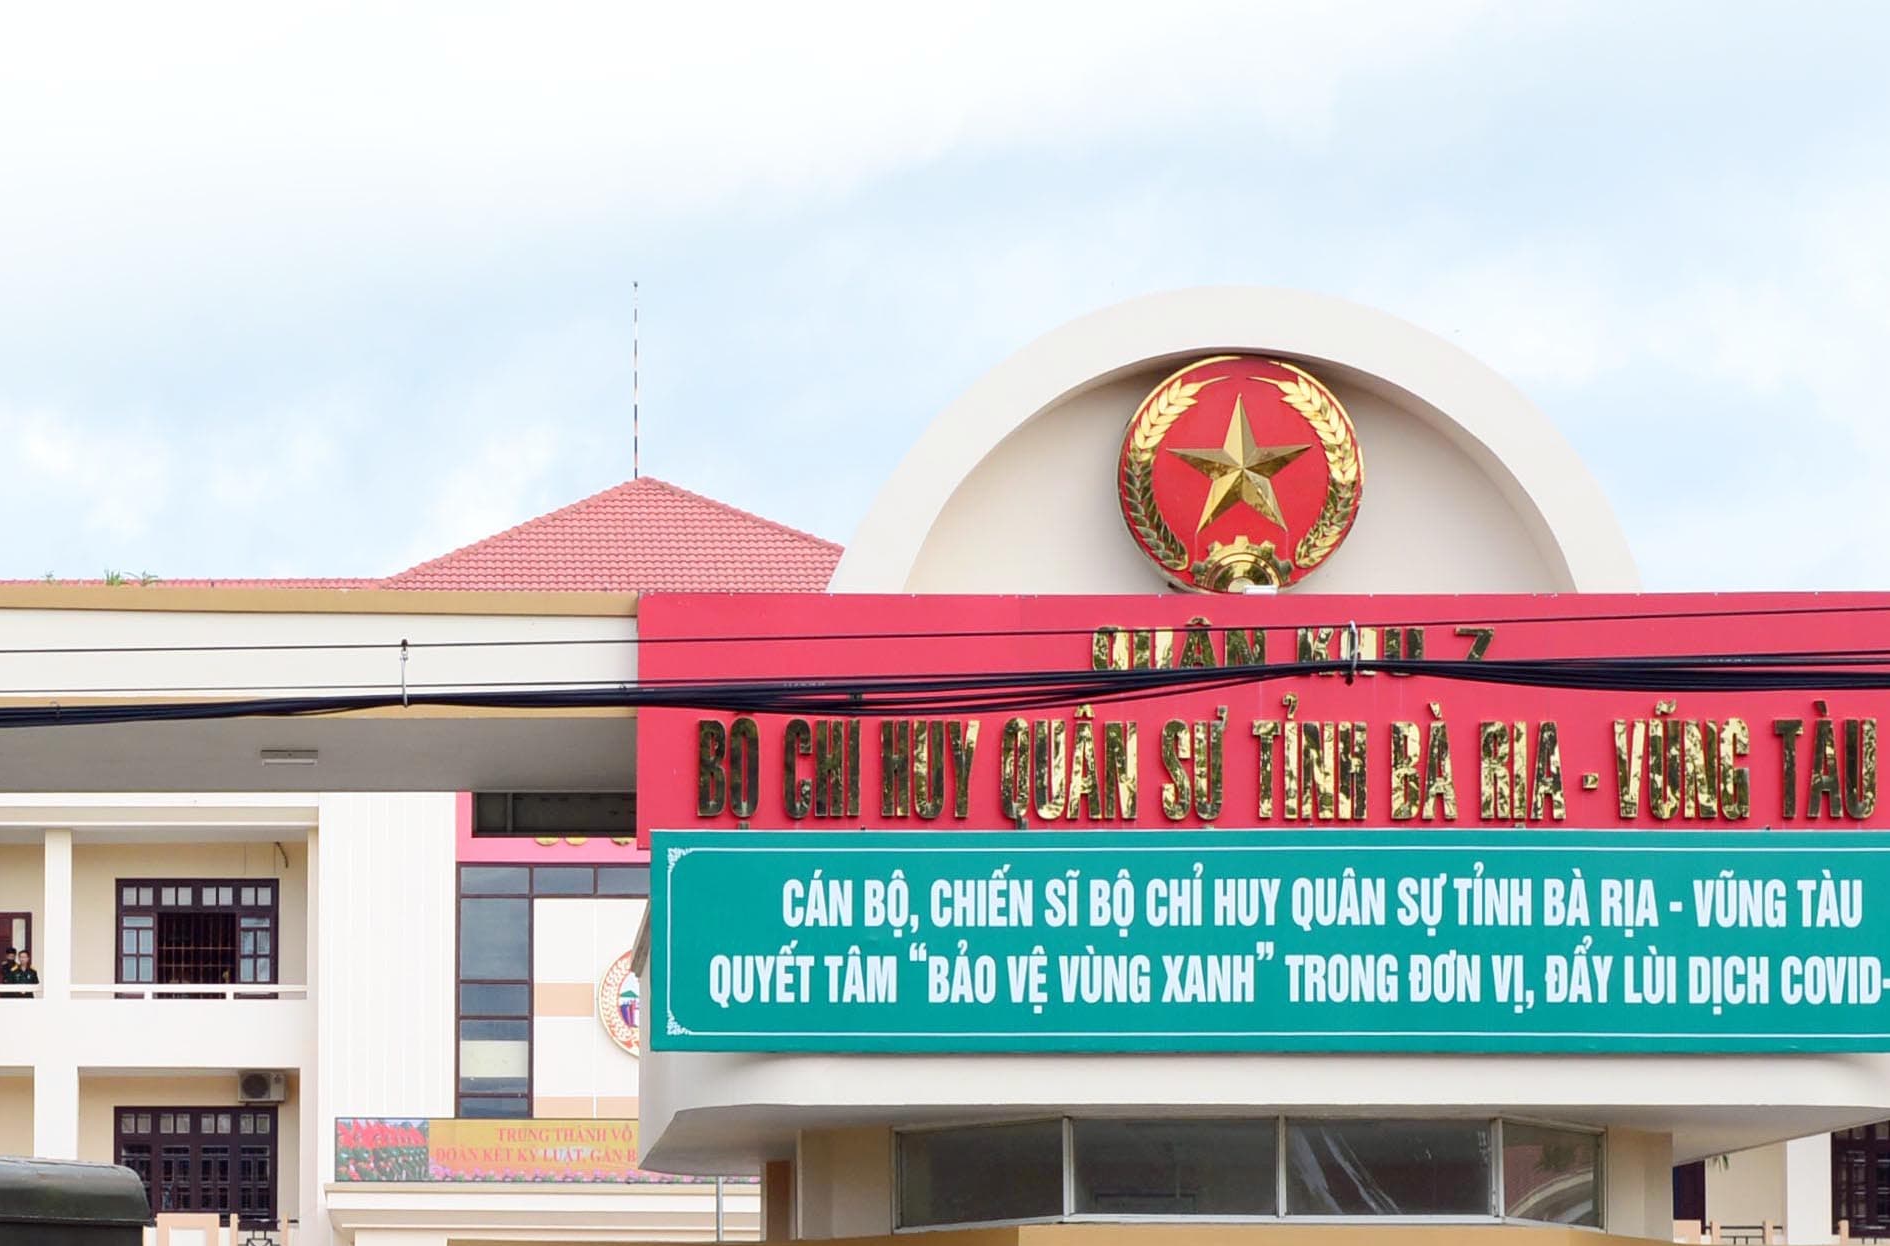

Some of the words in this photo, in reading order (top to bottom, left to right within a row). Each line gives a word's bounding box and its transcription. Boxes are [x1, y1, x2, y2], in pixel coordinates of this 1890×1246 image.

[782, 869, 853, 928] CÁN
[864, 869, 919, 938] BỘ,
[930, 864, 1034, 928] CHIẾN
[1044, 869, 1080, 928] SĨ
[1089, 868, 1135, 938] BỘ
[1146, 863, 1204, 927] CHỈ
[1214, 878, 1281, 927] HUY
[1291, 867, 1386, 932] QUÂN
[1397, 872, 1447, 937] SỰ
[1453, 862, 1532, 926] TỈNH
[1543, 868, 1592, 928] BÀ
[1600, 878, 1659, 938] RỊA
[1669, 901, 1683, 913] -
[1693, 869, 1787, 928] VŨNG
[1796, 869, 1863, 928] TÀU
[709, 939, 815, 1008] QUYẾT
[824, 945, 897, 1003] TÂM
[909, 939, 996, 1004] “BẢO
[1007, 945, 1048, 1014] VỆ
[1058, 944, 1151, 1004] VÙNG
[1161, 941, 1275, 1003] XANH”
[1284, 953, 1399, 1003] TRONG
[1408, 949, 1481, 1003] ĐƠN
[1491, 954, 1535, 1014] VỊ,
[1544, 937, 1614, 1004] ĐẨY
[1624, 945, 1677, 1005] LÙI
[1688, 955, 1770, 1015] DỊCH
